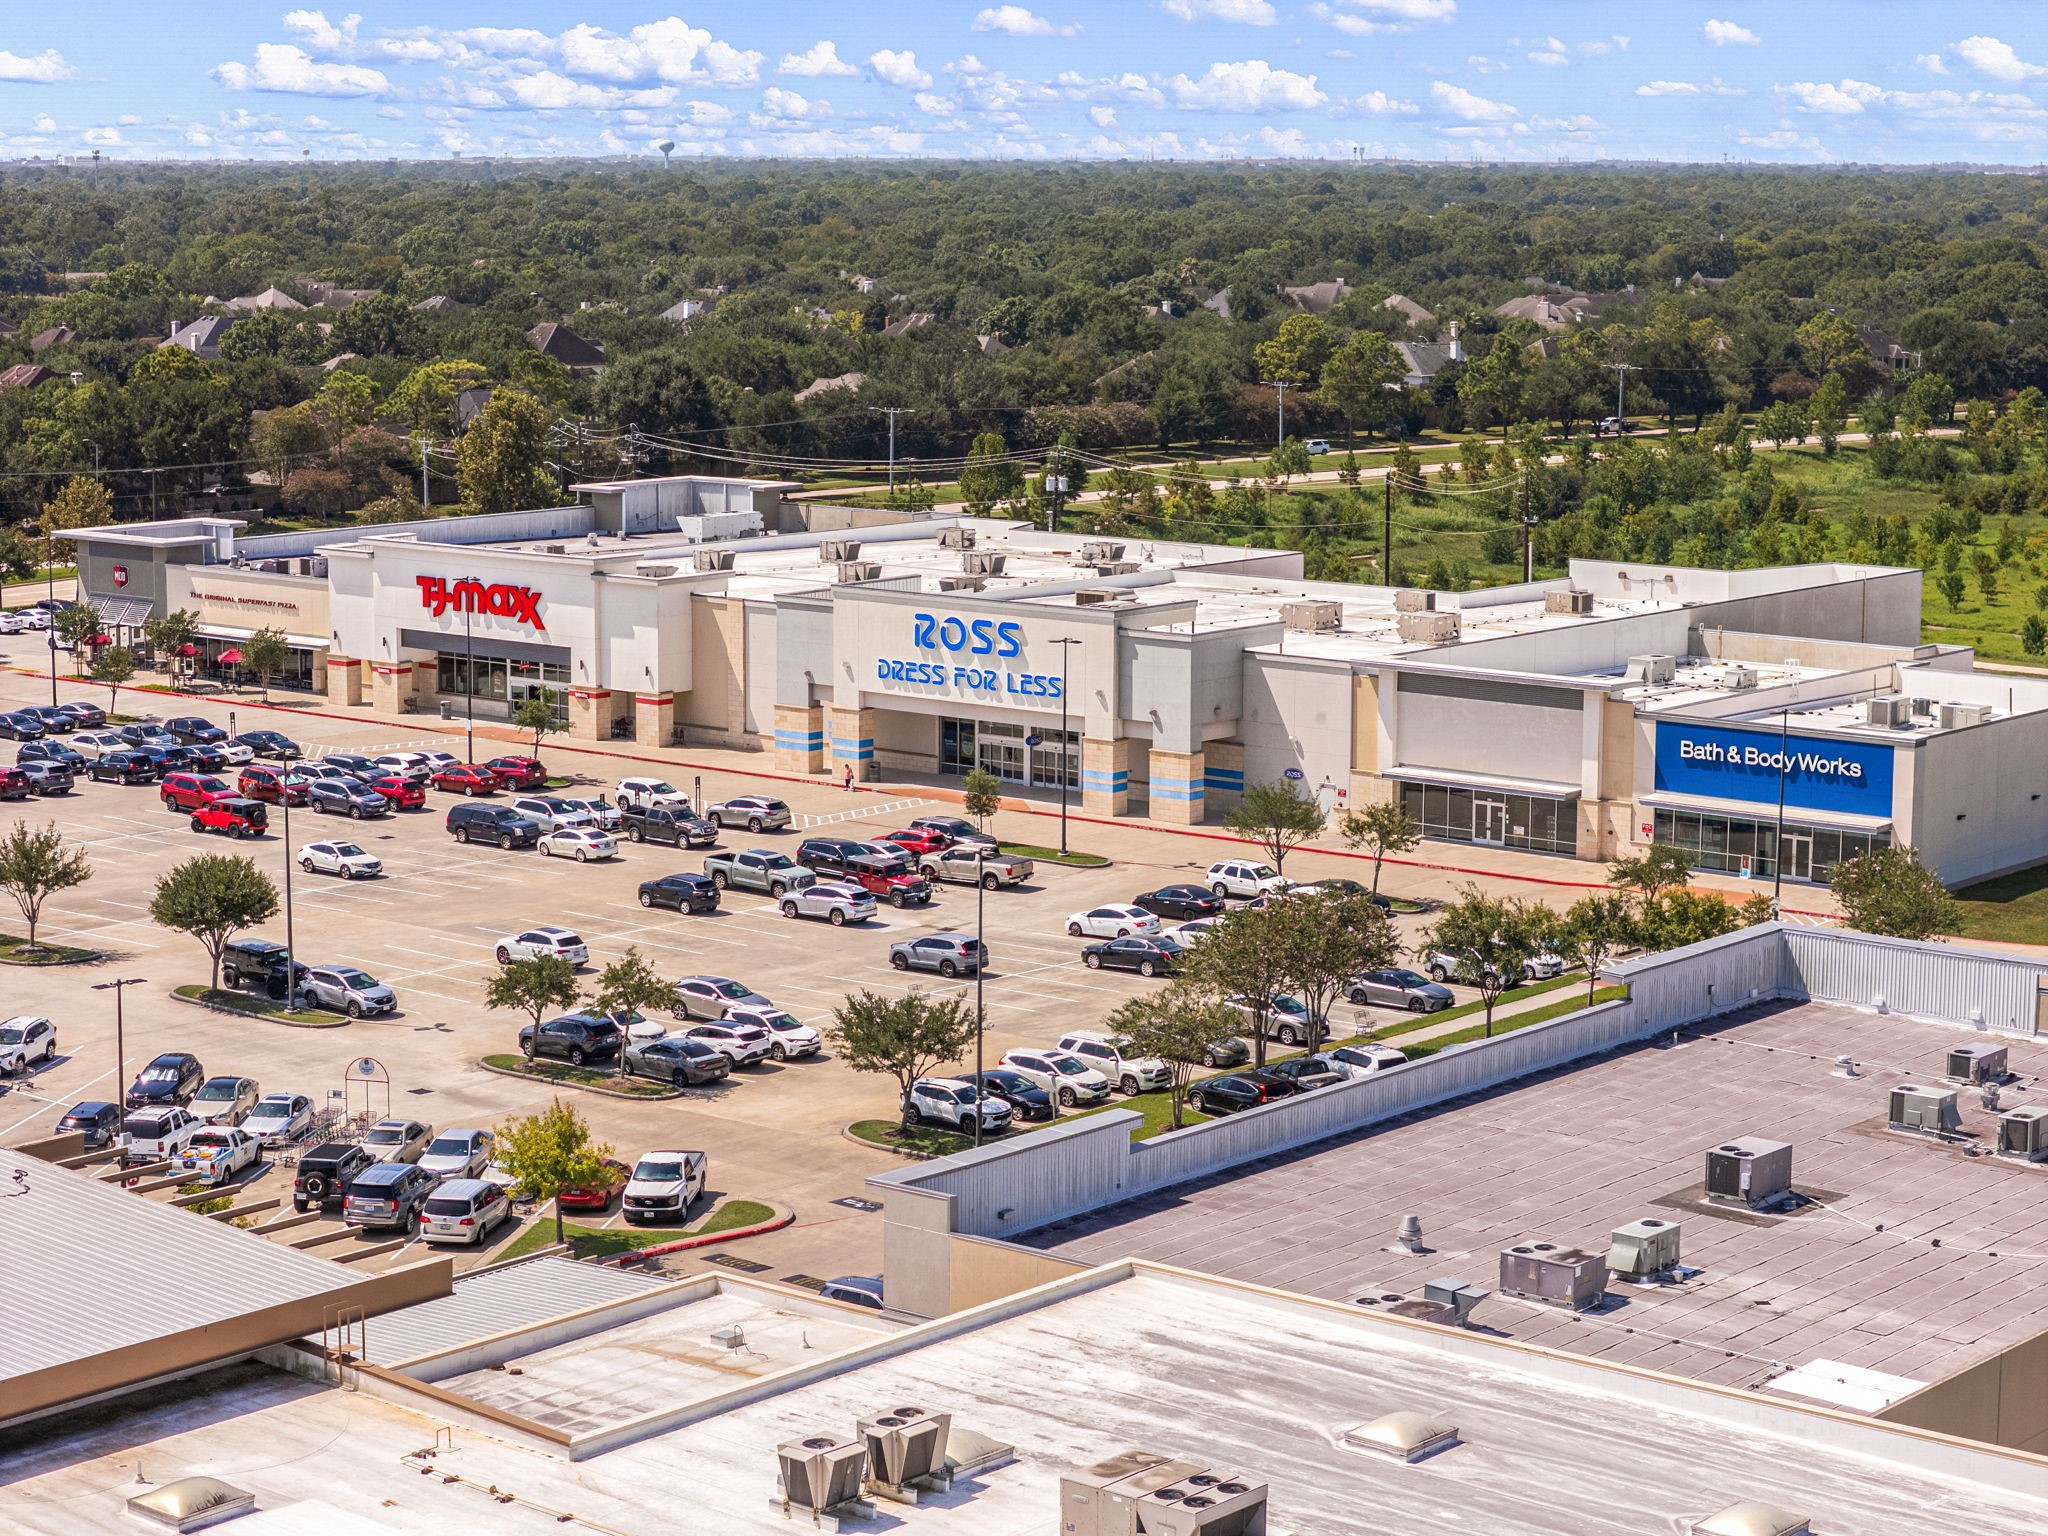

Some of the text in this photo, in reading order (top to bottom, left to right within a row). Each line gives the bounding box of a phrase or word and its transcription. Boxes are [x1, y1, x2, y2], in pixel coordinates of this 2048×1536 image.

[114, 571, 126, 582] MOD
[204, 594, 236, 603] ORIGINAL
[237, 597, 276, 607] SUPERFAST
[277, 602, 297, 610] PIZZA
[914, 613, 1020, 658] ROSS
[877, 658, 1063, 698] DRESS FOR LESS
[1680, 740, 1862, 777] Bath & Body Works
